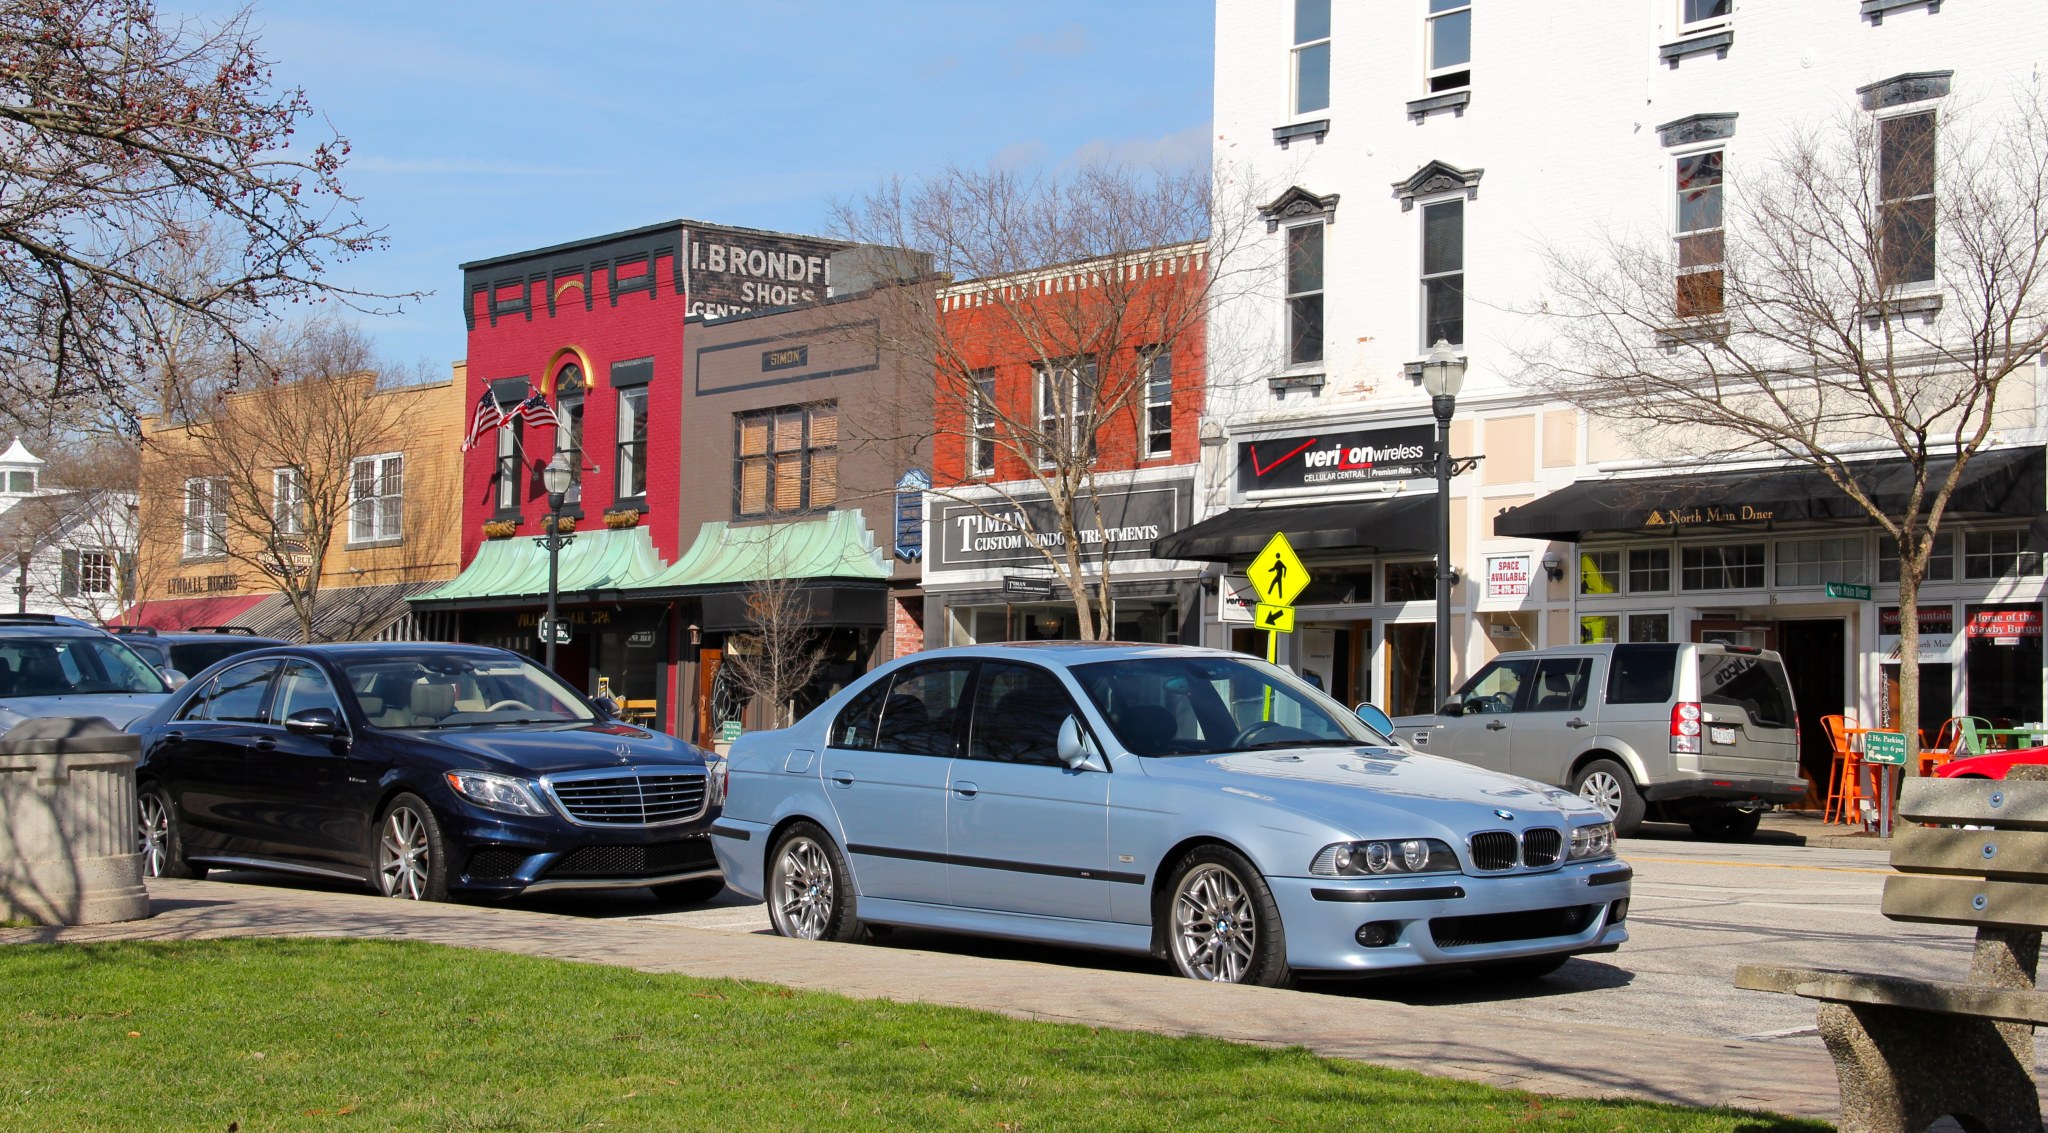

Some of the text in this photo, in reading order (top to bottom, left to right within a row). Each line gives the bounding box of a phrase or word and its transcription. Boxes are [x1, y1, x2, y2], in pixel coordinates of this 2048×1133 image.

[741, 281, 815, 306] SHOES
[770, 350, 800, 366] SIMON
[1304, 473, 1336, 483] CELLULAR
[1337, 470, 1366, 480] CENTRAL
[1372, 468, 1398, 477] Premium
[1668, 508, 1702, 524] North
[957, 511, 1027, 552] TIMAN
[975, 534, 1022, 551] CUSTOM
[1498, 561, 1520, 571] SPACE
[1491, 572, 1527, 582] AVAILABLE
[1769, 594, 1777, 605] 16
[591, 610, 611, 624] SPA
[1974, 612, 2036, 622] Home of the
[557, 630, 568, 638] SPA
[1969, 624, 2043, 634] Mawby Burger
[1883, 735, 1904, 745] Parking
